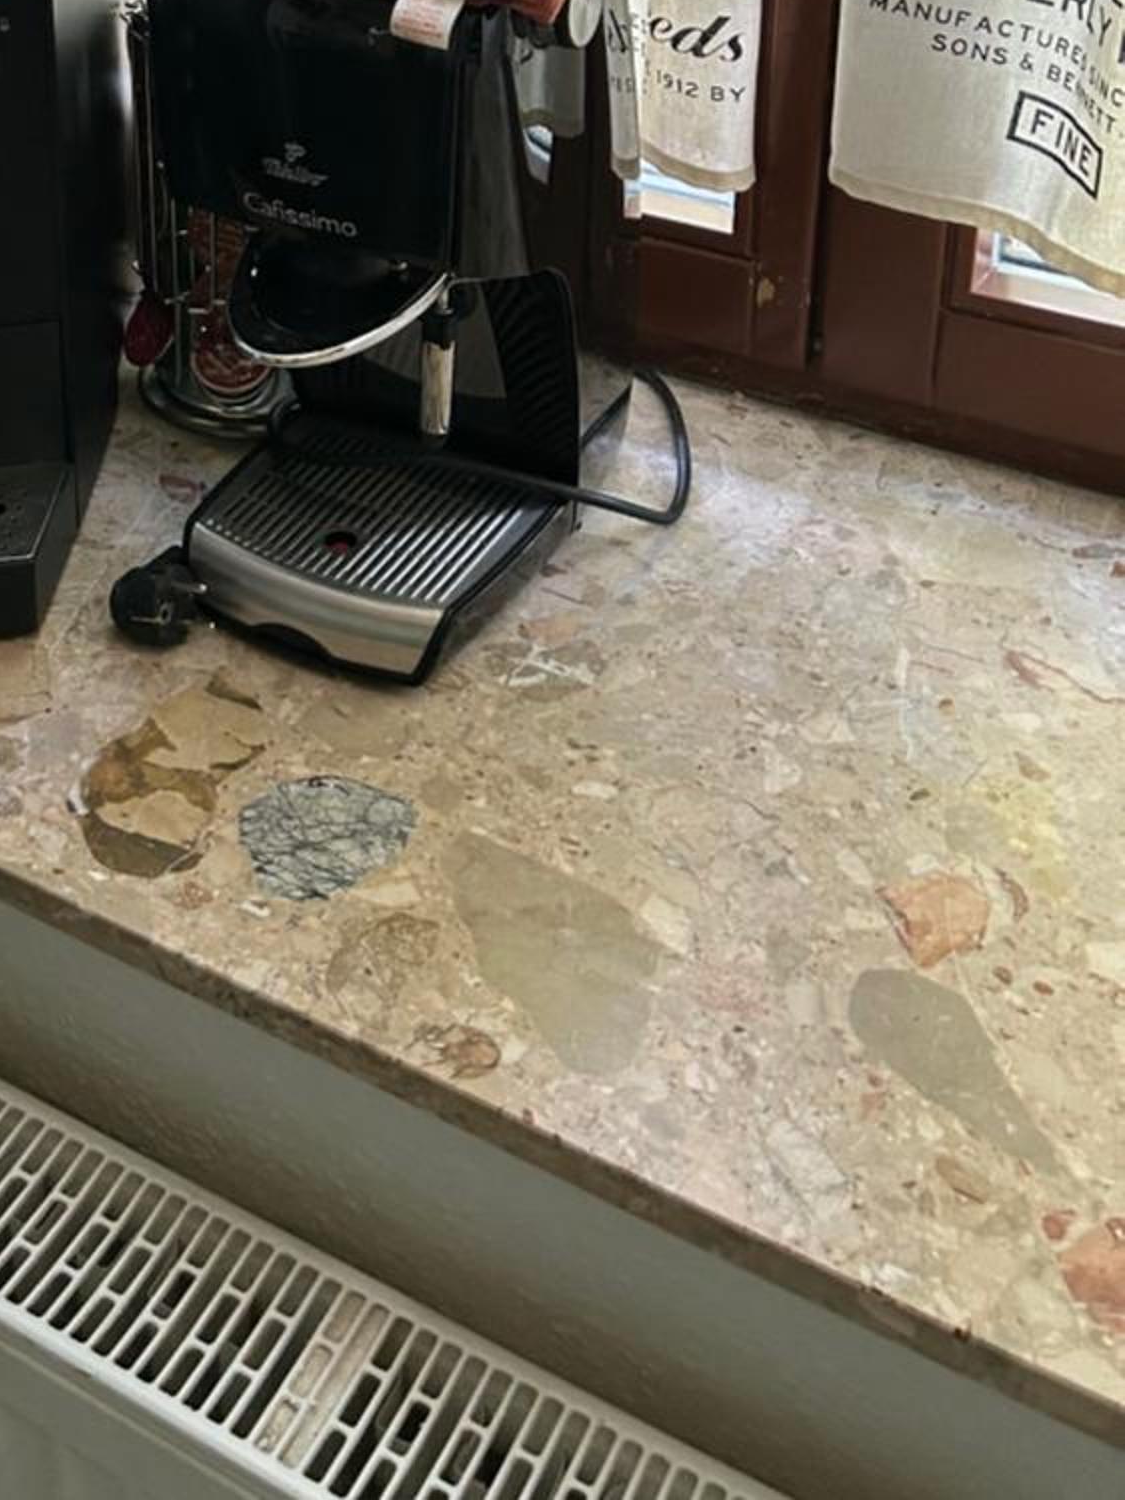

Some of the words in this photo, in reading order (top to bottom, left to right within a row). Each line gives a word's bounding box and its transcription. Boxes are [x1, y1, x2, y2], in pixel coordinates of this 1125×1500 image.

[931, 34, 1008, 67] SONS
[1018, 52, 1034, 71] &
[656, 69, 699, 98] 1912
[710, 86, 746, 103] BY
[1031, 108, 1094, 177] FINE
[242, 191, 358, 238] Cafissimo
